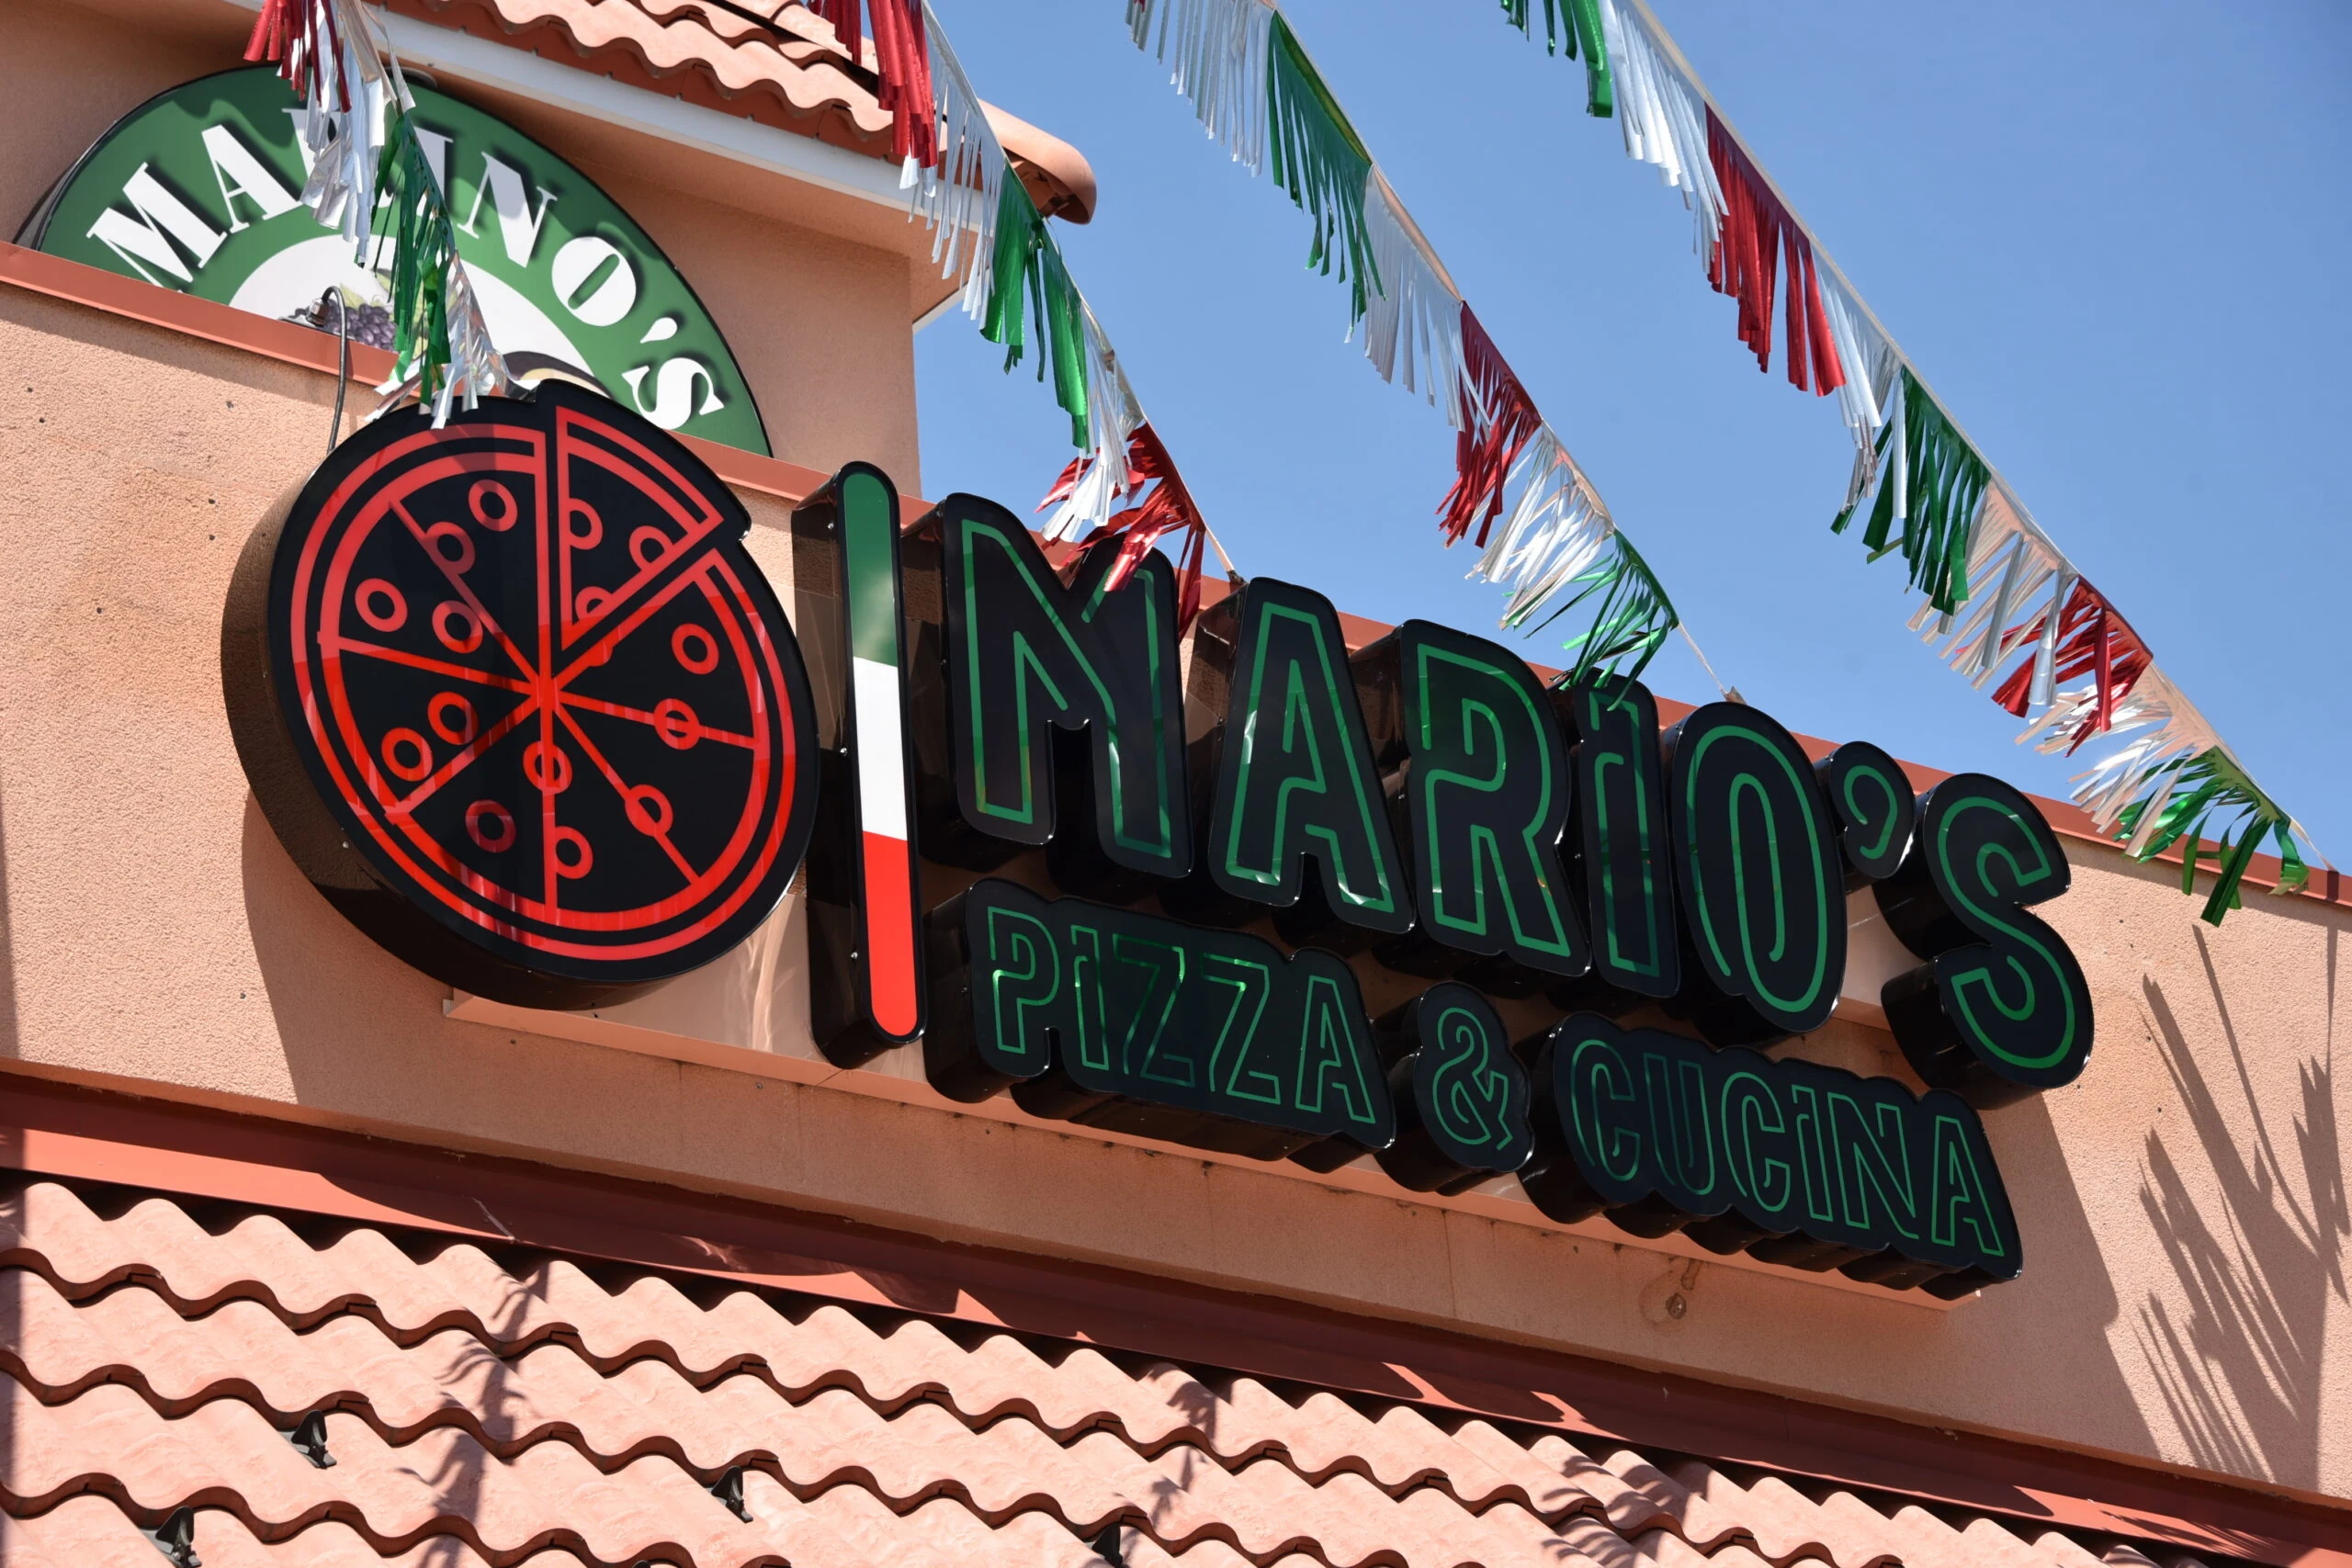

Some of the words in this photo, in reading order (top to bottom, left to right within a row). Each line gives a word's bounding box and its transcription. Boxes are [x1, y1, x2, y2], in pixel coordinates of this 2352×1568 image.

[85, 107, 725, 431] MAINO'S
[987, 905, 1376, 1123] PIZZA
[1431, 1007, 1513, 1150] &
[1571, 1038, 2005, 1258] CUCINA
